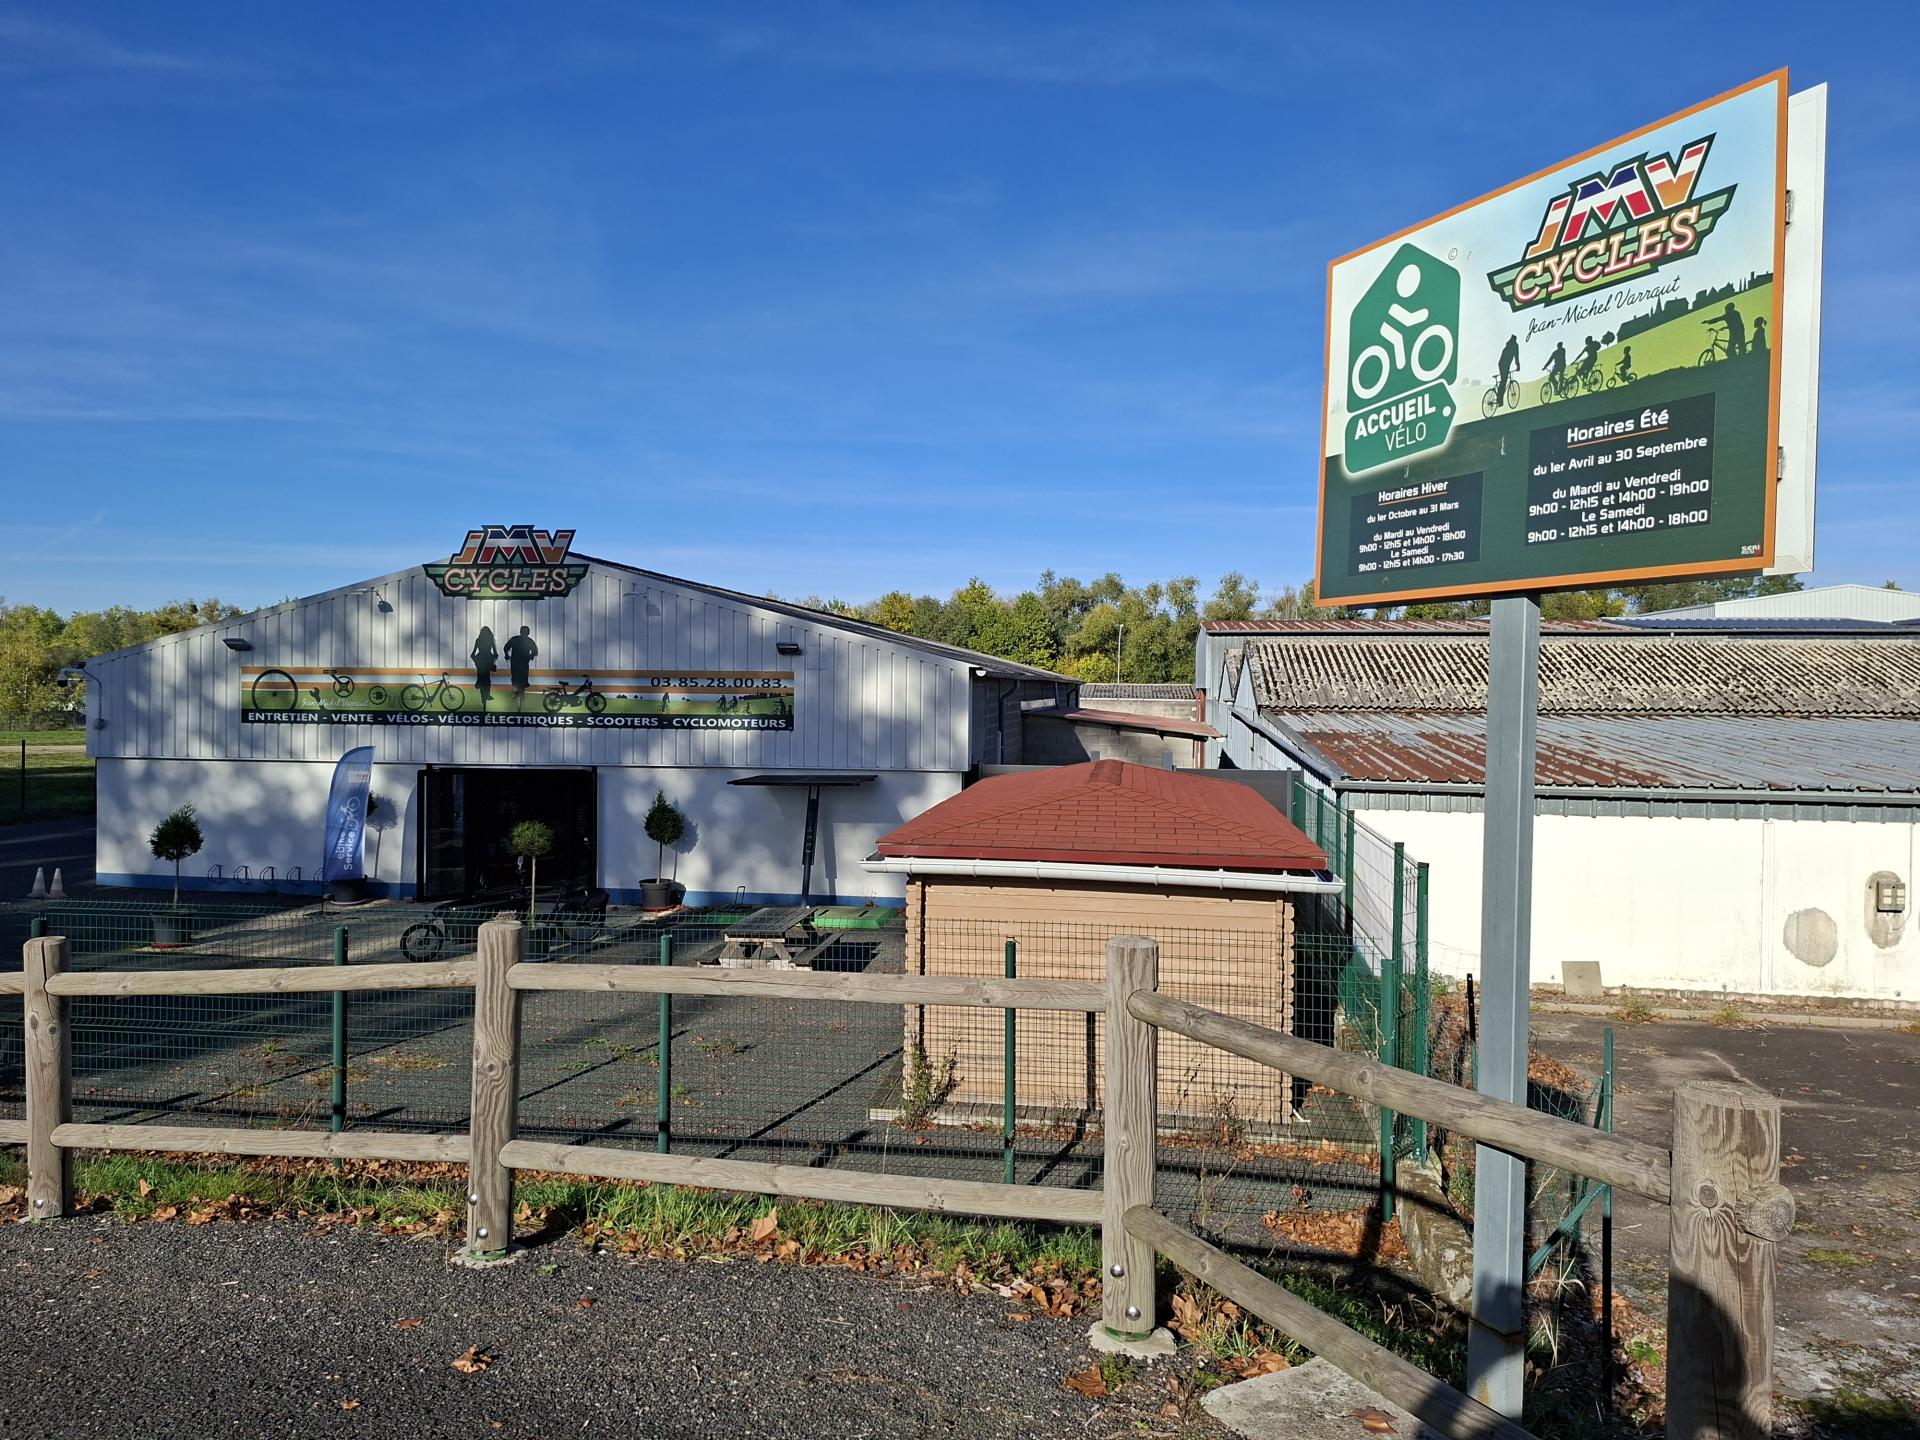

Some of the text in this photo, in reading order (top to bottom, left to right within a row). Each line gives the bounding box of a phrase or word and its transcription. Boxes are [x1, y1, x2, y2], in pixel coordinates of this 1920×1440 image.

[1525, 141, 1709, 259] JMV
[1513, 204, 1700, 303] CYCLES
[1526, 275, 1680, 343] Jean-Michel Varraut
[1354, 393, 1436, 440] ACCUEIL
[1567, 409, 1669, 443] Horaires Été
[1385, 422, 1426, 451] VÉLO
[1533, 465, 1547, 476] du
[1569, 455, 1594, 470] Avril
[1598, 454, 1611, 464] au
[1615, 449, 1633, 462] 30
[1636, 436, 1707, 458] Septembre
[1378, 481, 1448, 502] Horaires Hiver
[1529, 503, 1558, 516] 9h00
[1570, 496, 1598, 511] 12h15
[1602, 494, 1615, 505] et
[1619, 488, 1656, 503] 14h00
[1670, 480, 1709, 496] 19h00
[1552, 469, 1681, 499] du Mardi au Vendredi
[1367, 515, 1376, 523] du
[1388, 509, 1417, 520] Octobre
[1419, 507, 1428, 515] au
[1430, 504, 1438, 512] 31
[1440, 501, 1459, 512] Mars
[1528, 529, 1557, 542] 9h00
[1569, 523, 1597, 537] 12h15
[1601, 523, 1613, 533] et
[1618, 516, 1654, 531] 14h00
[1668, 510, 1708, 526] 18h00
[1581, 503, 1645, 523] Le Samedi
[1359, 543, 1377, 553] 9h00
[1384, 540, 1401, 550] 12h15
[1403, 538, 1411, 547] et
[1413, 535, 1435, 545] 14h00
[1442, 530, 1466, 541] 18h00
[1373, 522, 1450, 541] du Mardi au Vendredi
[452, 529, 572, 564] JMV
[1390, 546, 1428, 558] Le Samedi
[1358, 562, 1376, 572] 9h00
[1383, 559, 1400, 569] 12h15
[1403, 558, 1410, 566] et
[1412, 555, 1434, 565] 14h00
[1442, 551, 1464, 561] 17h30
[444, 567, 568, 592] CYCLES
[650, 677, 788, 688] 03.85.28.00.83.
[248, 712, 318, 721] ENTRETIEN
[332, 714, 374, 722] VENTE
[438, 713, 480, 723] VÉLOS
[485, 714, 573, 726] ÉLECTRIQUES
[587, 717, 658, 726] SCOOTERS
[673, 718, 786, 728] CYCLOMOTEURS
[344, 832, 355, 870] Service
